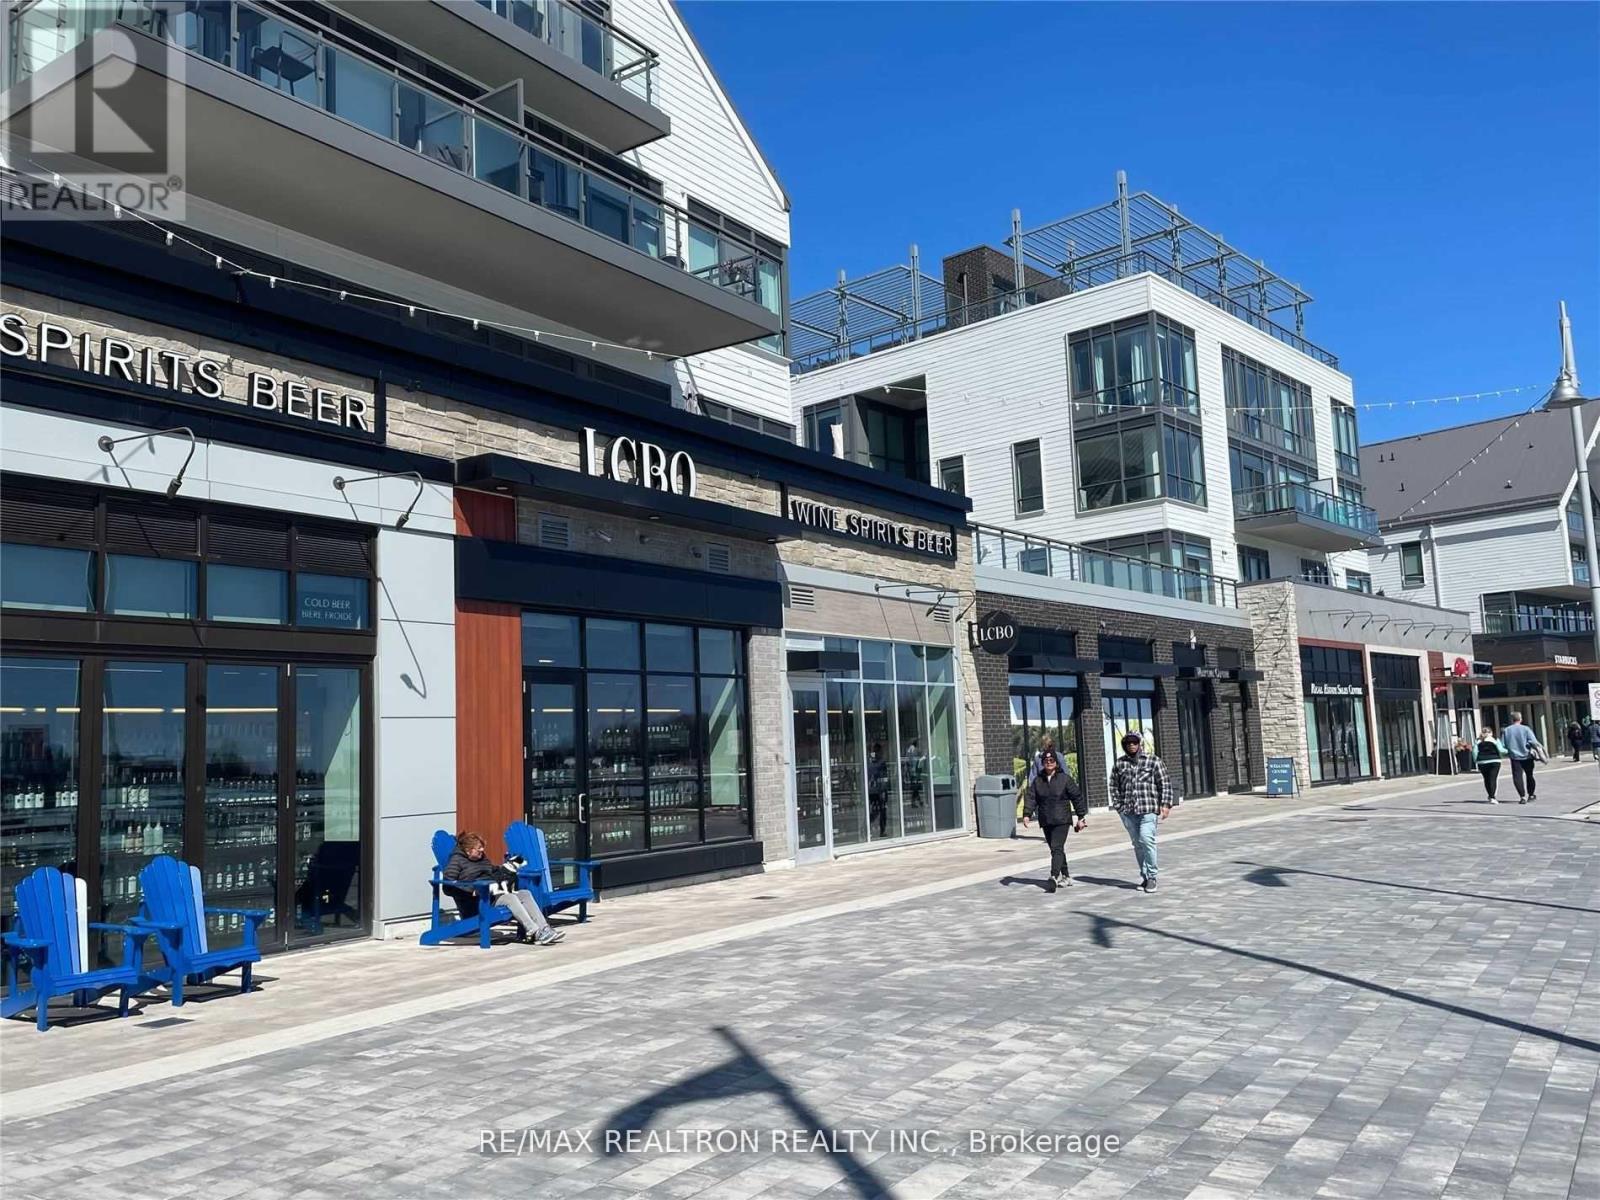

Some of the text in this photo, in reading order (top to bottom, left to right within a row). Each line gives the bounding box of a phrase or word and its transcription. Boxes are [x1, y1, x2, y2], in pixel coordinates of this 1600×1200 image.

[0, 314, 368, 432] SPIRITS BEER
[582, 426, 697, 497] LCBO
[797, 502, 953, 557] WINE SPIRITS BEER
[304, 597, 351, 609] COLD BEER
[980, 624, 1014, 641] LCBO
[1554, 655, 1578, 666] STARBUCKS
